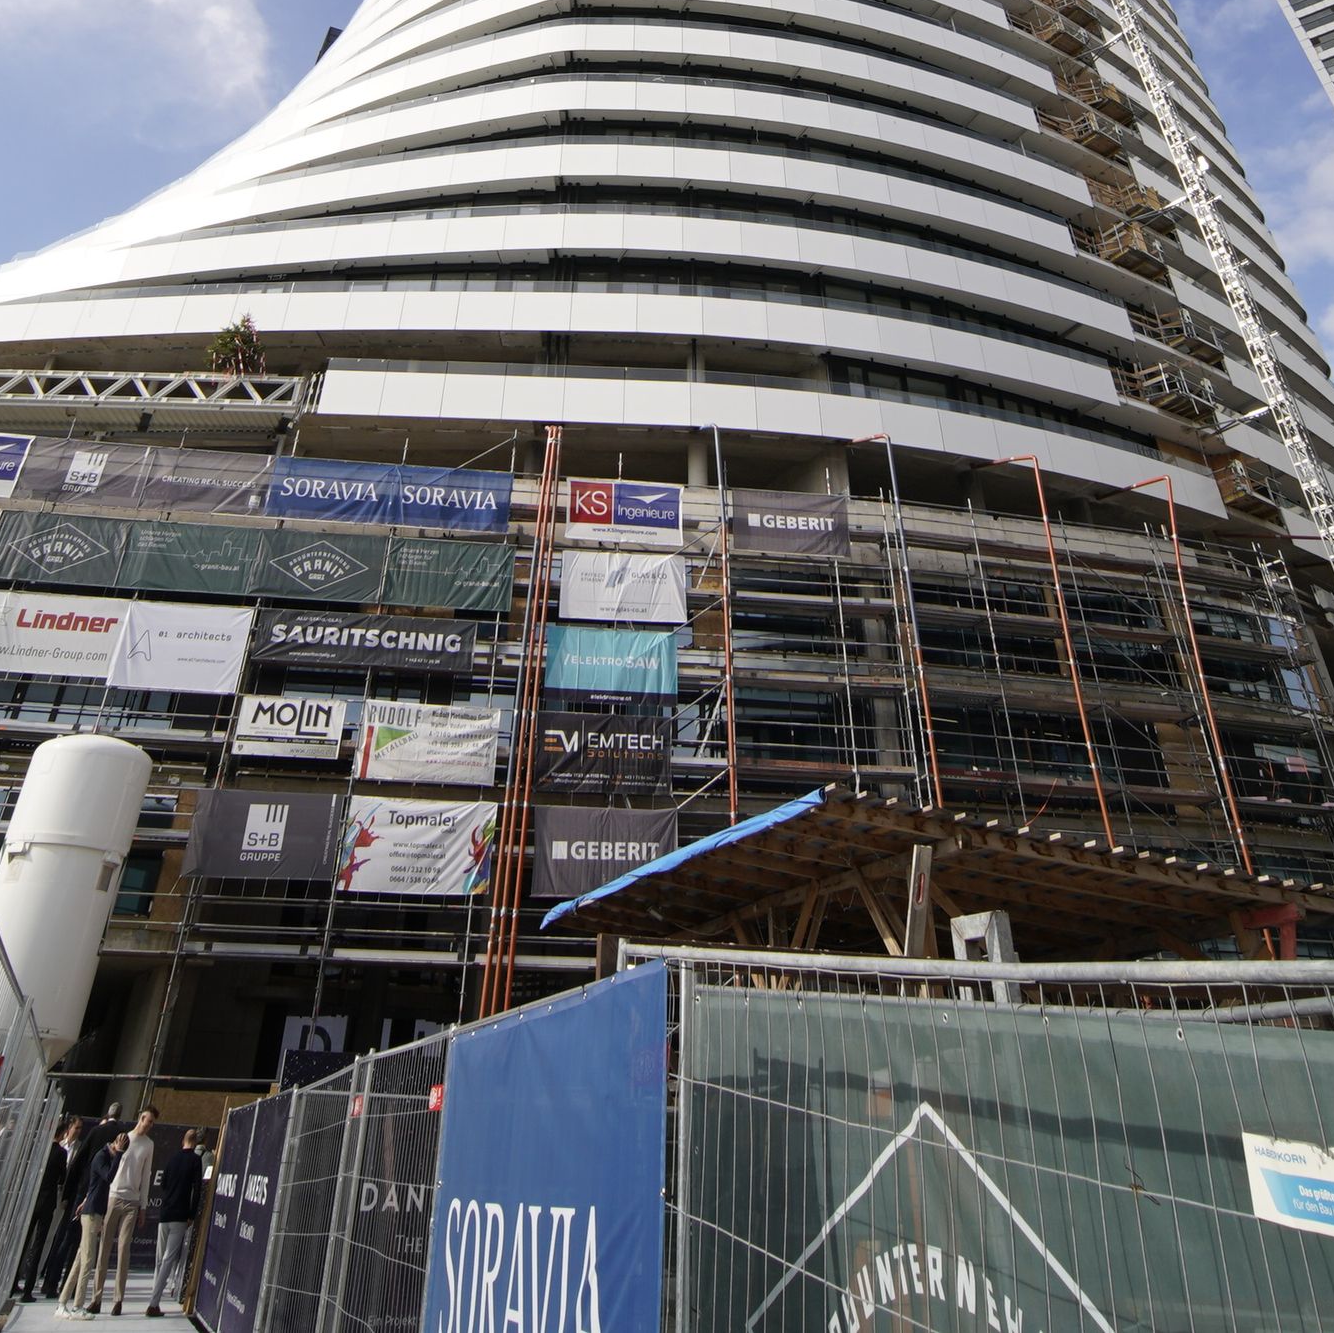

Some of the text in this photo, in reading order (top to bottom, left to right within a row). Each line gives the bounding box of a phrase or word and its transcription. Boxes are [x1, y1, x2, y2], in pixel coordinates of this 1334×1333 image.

[70, 470, 98, 483] S+B
[162, 475, 256, 489] CREATING REAL SUCCESS
[62, 483, 97, 494] GRUPPE
[280, 477, 378, 502] SORAVIA
[401, 484, 498, 510] SORAVIA
[575, 490, 675, 520] KS Ingenieure
[762, 514, 834, 531] GEBERIT
[31, 541, 84, 561] GRANIT
[292, 559, 345, 578] GRANIT
[16, 608, 118, 634] Lindner
[176, 629, 232, 642] architects
[270, 623, 462, 653] SAURITSCHNIG
[251, 700, 332, 736] MOLIN
[369, 705, 422, 727] RUDOLF
[374, 732, 419, 761] METALLBAU
[587, 732, 664, 750] EMTECH
[587, 749, 664, 761] Solutions
[389, 810, 458, 828] Topmaler
[247, 832, 280, 847] S+B
[240, 852, 282, 862] GRUPPE
[570, 840, 659, 861] GEBERIT
[1298, 1185, 1314, 1198] Das
[1293, 1198, 1304, 1210] für
[1305, 1201, 1319, 1212] den
[1320, 1203, 1333, 1216] Bau
[438, 1197, 602, 1333] SORAVIA
[368, 1314, 417, 1328] Ein Projekt
